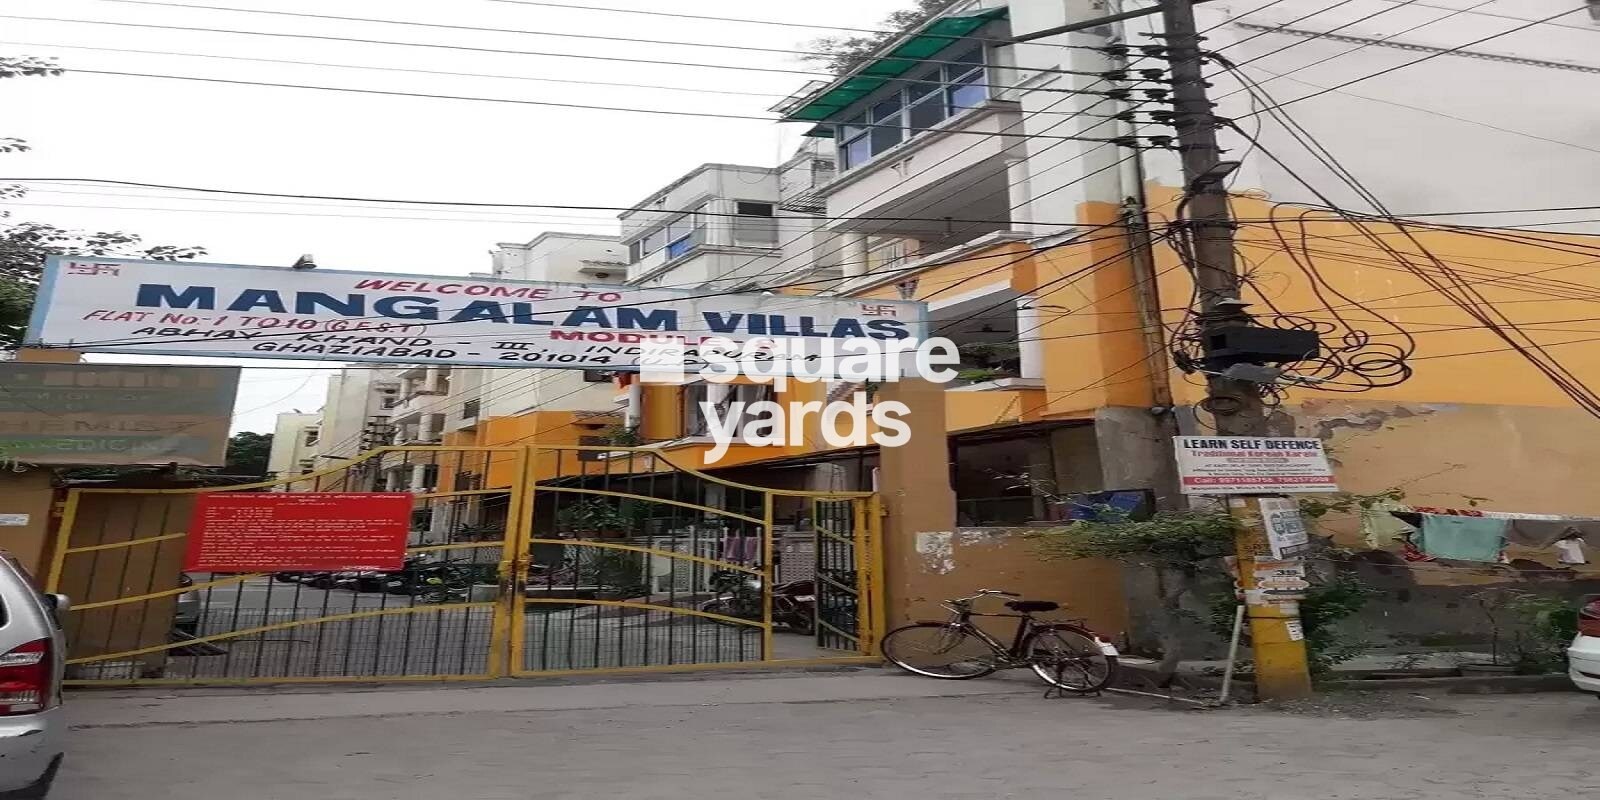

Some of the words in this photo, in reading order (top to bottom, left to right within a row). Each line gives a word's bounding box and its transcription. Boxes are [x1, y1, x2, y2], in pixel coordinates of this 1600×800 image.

[355, 279, 552, 299] WELCOME
[574, 290, 621, 303] TO
[83, 310, 154, 322] FLAT
[136, 283, 677, 331] MANGALAM
[703, 310, 909, 339] VILLAS
[131, 326, 262, 340] ABHAY
[299, 333, 433, 347] KHAND
[252, 342, 457, 359] GHAZIABAD
[499, 352, 611, 363] 201014
[1184, 439, 1228, 449] LEARN
[1231, 439, 1261, 450] SELF
[1265, 440, 1321, 450] DEFENCE
